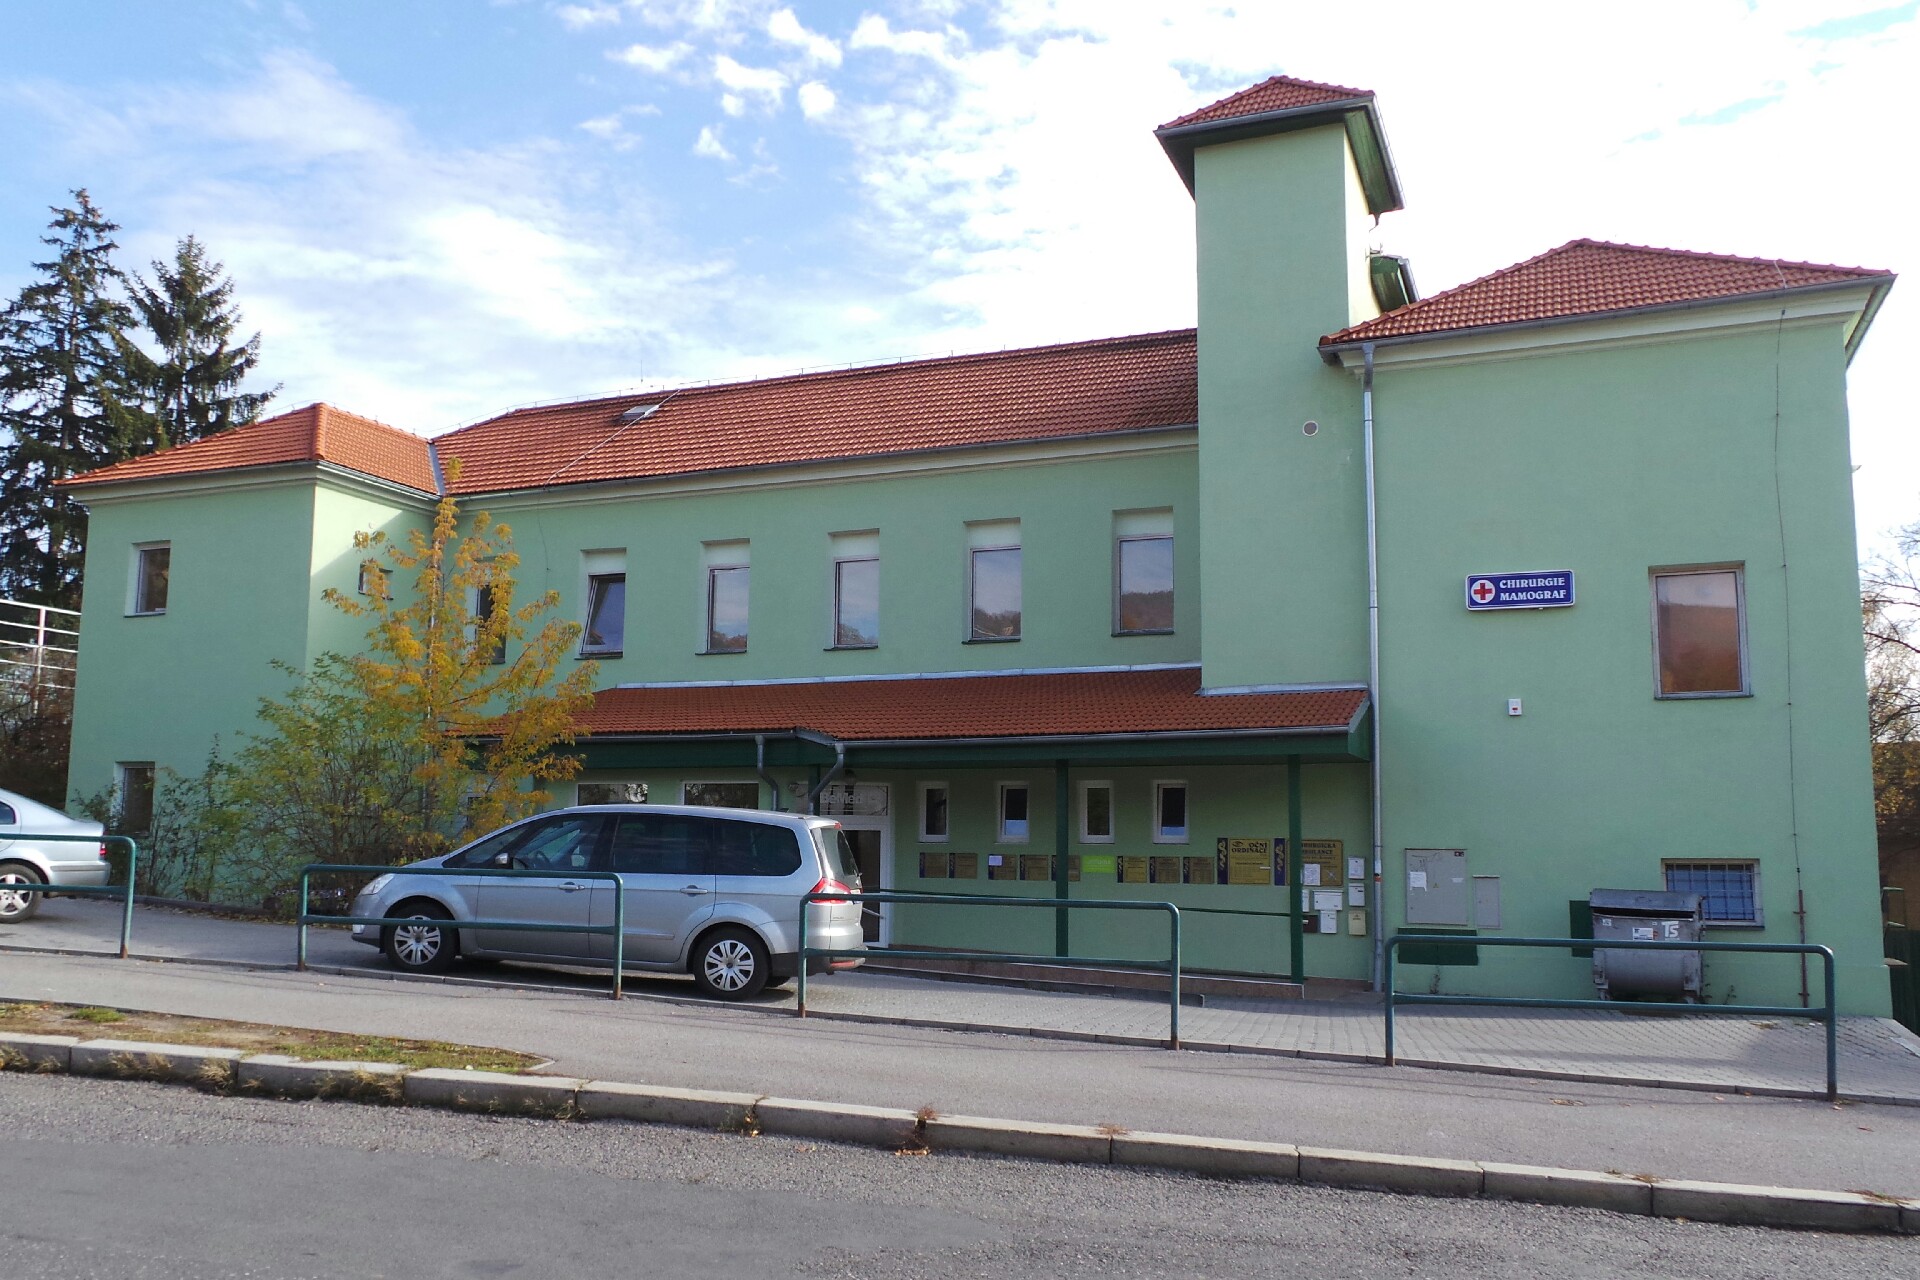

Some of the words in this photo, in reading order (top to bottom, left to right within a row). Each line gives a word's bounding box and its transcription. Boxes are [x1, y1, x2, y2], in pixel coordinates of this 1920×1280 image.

[1499, 577, 1565, 589] CHIRURGIE
[1499, 589, 1566, 601] MAMOGRAF
[1661, 920, 1679, 938] TS
